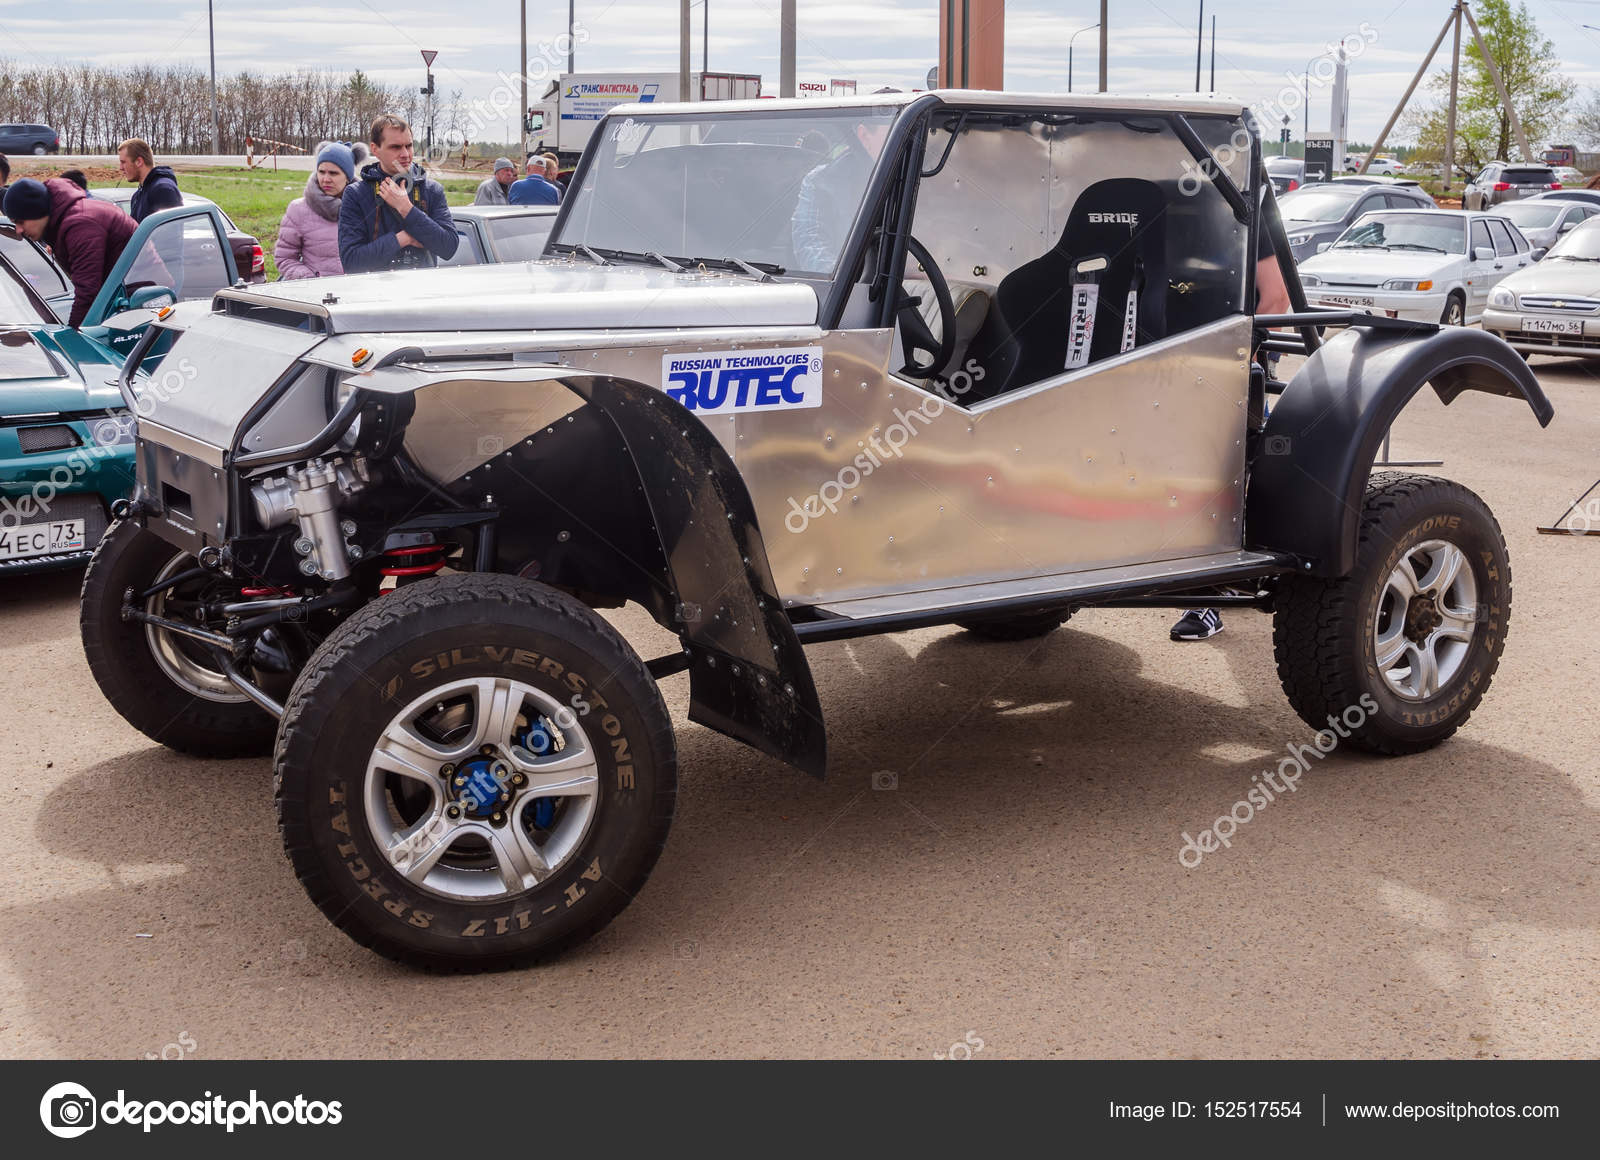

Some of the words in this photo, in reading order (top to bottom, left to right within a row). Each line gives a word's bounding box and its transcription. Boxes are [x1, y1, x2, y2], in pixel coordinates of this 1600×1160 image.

[581, 84, 639, 93] ТРАНСМАГИСТРАЛЬ
[799, 83, 826, 91] ISUZU
[1306, 140, 1331, 148] ВЪЕЗД
[1088, 213, 1138, 224] BRIDE
[1072, 291, 1087, 361] BRIDE
[1568, 322, 1579, 330] 56
[670, 359, 722, 371] RUSSIAN
[726, 354, 809, 368] TECHNOLOGIES
[667, 365, 808, 410] RUTEC
[53, 523, 76, 541] 73
[51, 541, 69, 549] RUS
[1402, 669, 1481, 727] SPECIAL
[410, 646, 635, 791] SILVERSTONE
[329, 781, 434, 929] SPECIAL
